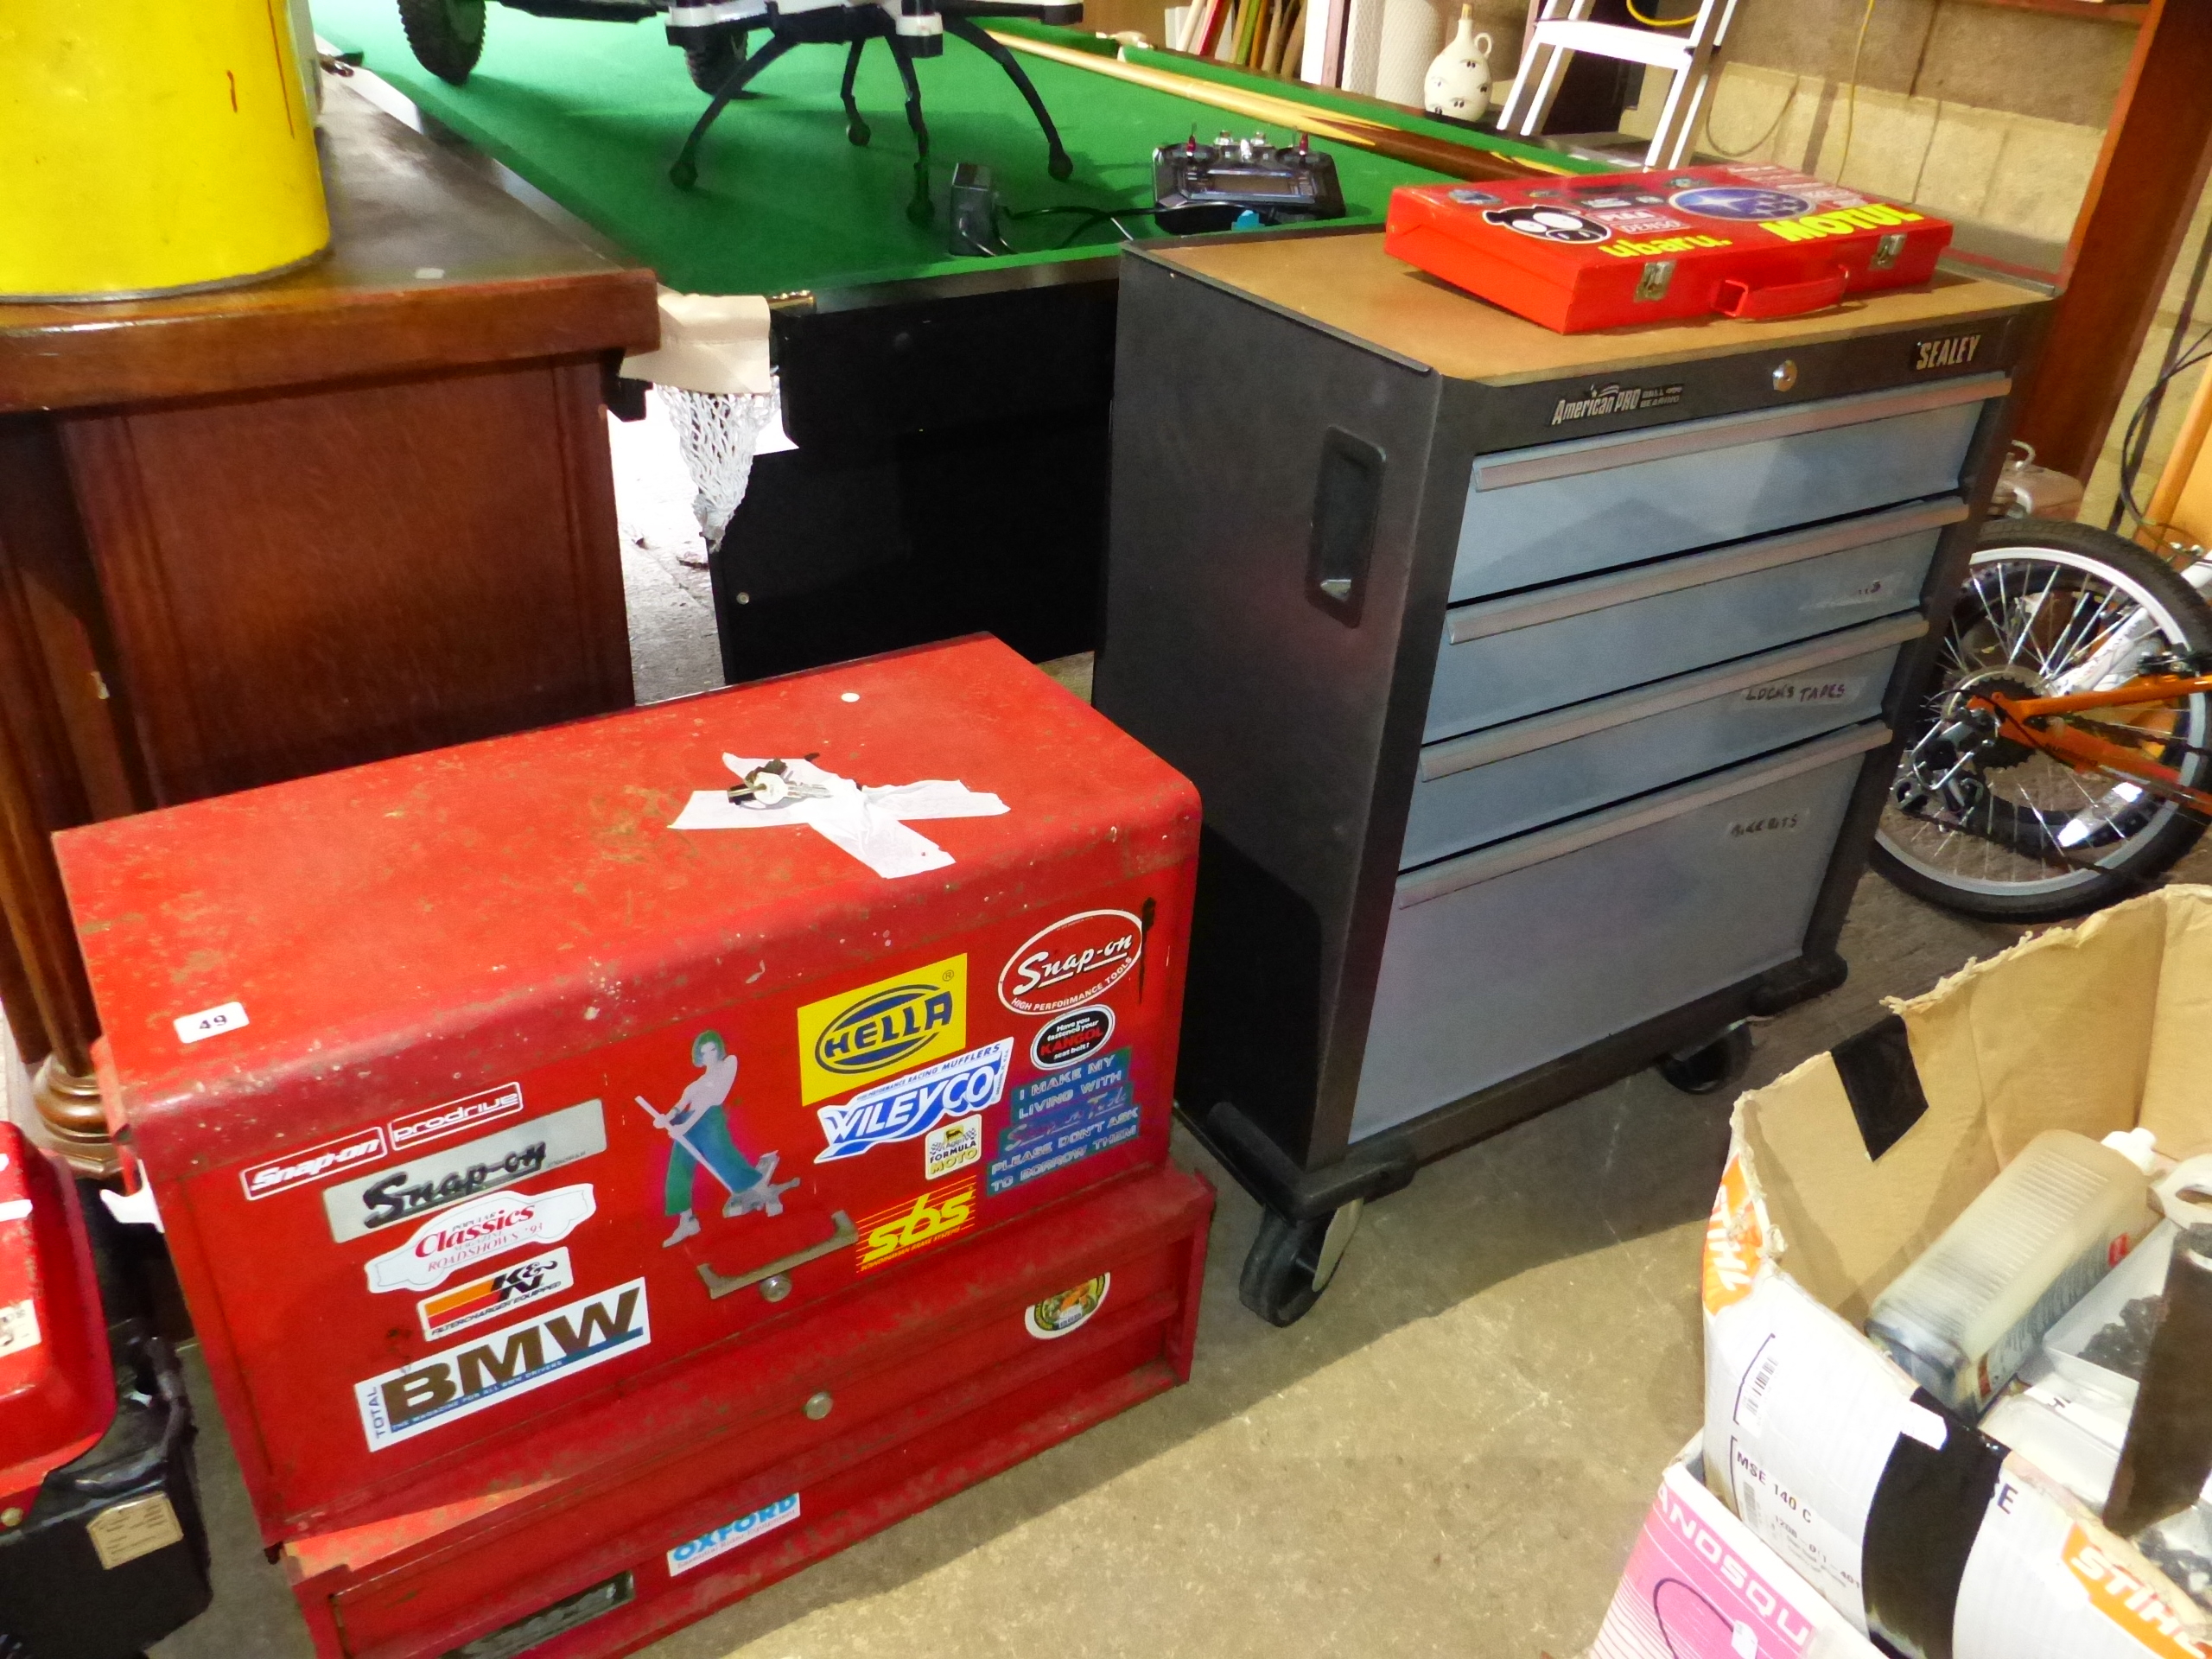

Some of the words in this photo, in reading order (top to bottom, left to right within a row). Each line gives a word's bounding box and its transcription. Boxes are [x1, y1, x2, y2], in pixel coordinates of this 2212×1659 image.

[1622, 219, 1681, 232] DENSO
[1758, 203, 1924, 242] MOTUL
[1916, 334, 1981, 370] SEALEY
[1551, 395, 1615, 425] American
[1011, 997, 1033, 1011] HIGH
[1033, 983, 1103, 1011] PERFORMANCE
[1105, 957, 1133, 983] TOOLS
[1013, 934, 1134, 996] Snap-on
[199, 1014, 228, 1030] 49
[824, 990, 953, 1058] HELLA
[1081, 1020, 1100, 1032] your
[908, 1067, 938, 1083] RACING
[942, 1043, 1001, 1070] MUFFLERS
[1020, 1089, 1025, 1101] I
[1031, 1067, 1082, 1096] MAKE
[1087, 1054, 1116, 1074] MY
[823, 1065, 995, 1143] WILEYCO
[1019, 1089, 1074, 1120] LIVING
[1080, 1071, 1122, 1095] WITH
[250, 1138, 379, 1192] Snap-on
[930, 1140, 977, 1164] FORMULA
[930, 1147, 978, 1174] MOTO
[990, 1175, 1014, 1192] TO
[1020, 1144, 1089, 1181] BORROW
[1092, 1124, 1137, 1150] THEM
[991, 1141, 1053, 1175] PLEASE
[1058, 1121, 1106, 1147] DON'T
[1106, 1107, 1139, 1128] ASK
[362, 1141, 547, 1229] Snap-on
[415, 1205, 536, 1258] Classics
[452, 1211, 497, 1232] POPULAR
[428, 1232, 519, 1272] ROADSHOWS
[381, 1287, 640, 1430] BMW
[366, 1385, 386, 1440] TOTAL
[1737, 1451, 1767, 1485] MSE
[1774, 1483, 1797, 1510] 140
[1802, 1509, 1812, 1523] C
[674, 1495, 797, 1560] OXFORD
